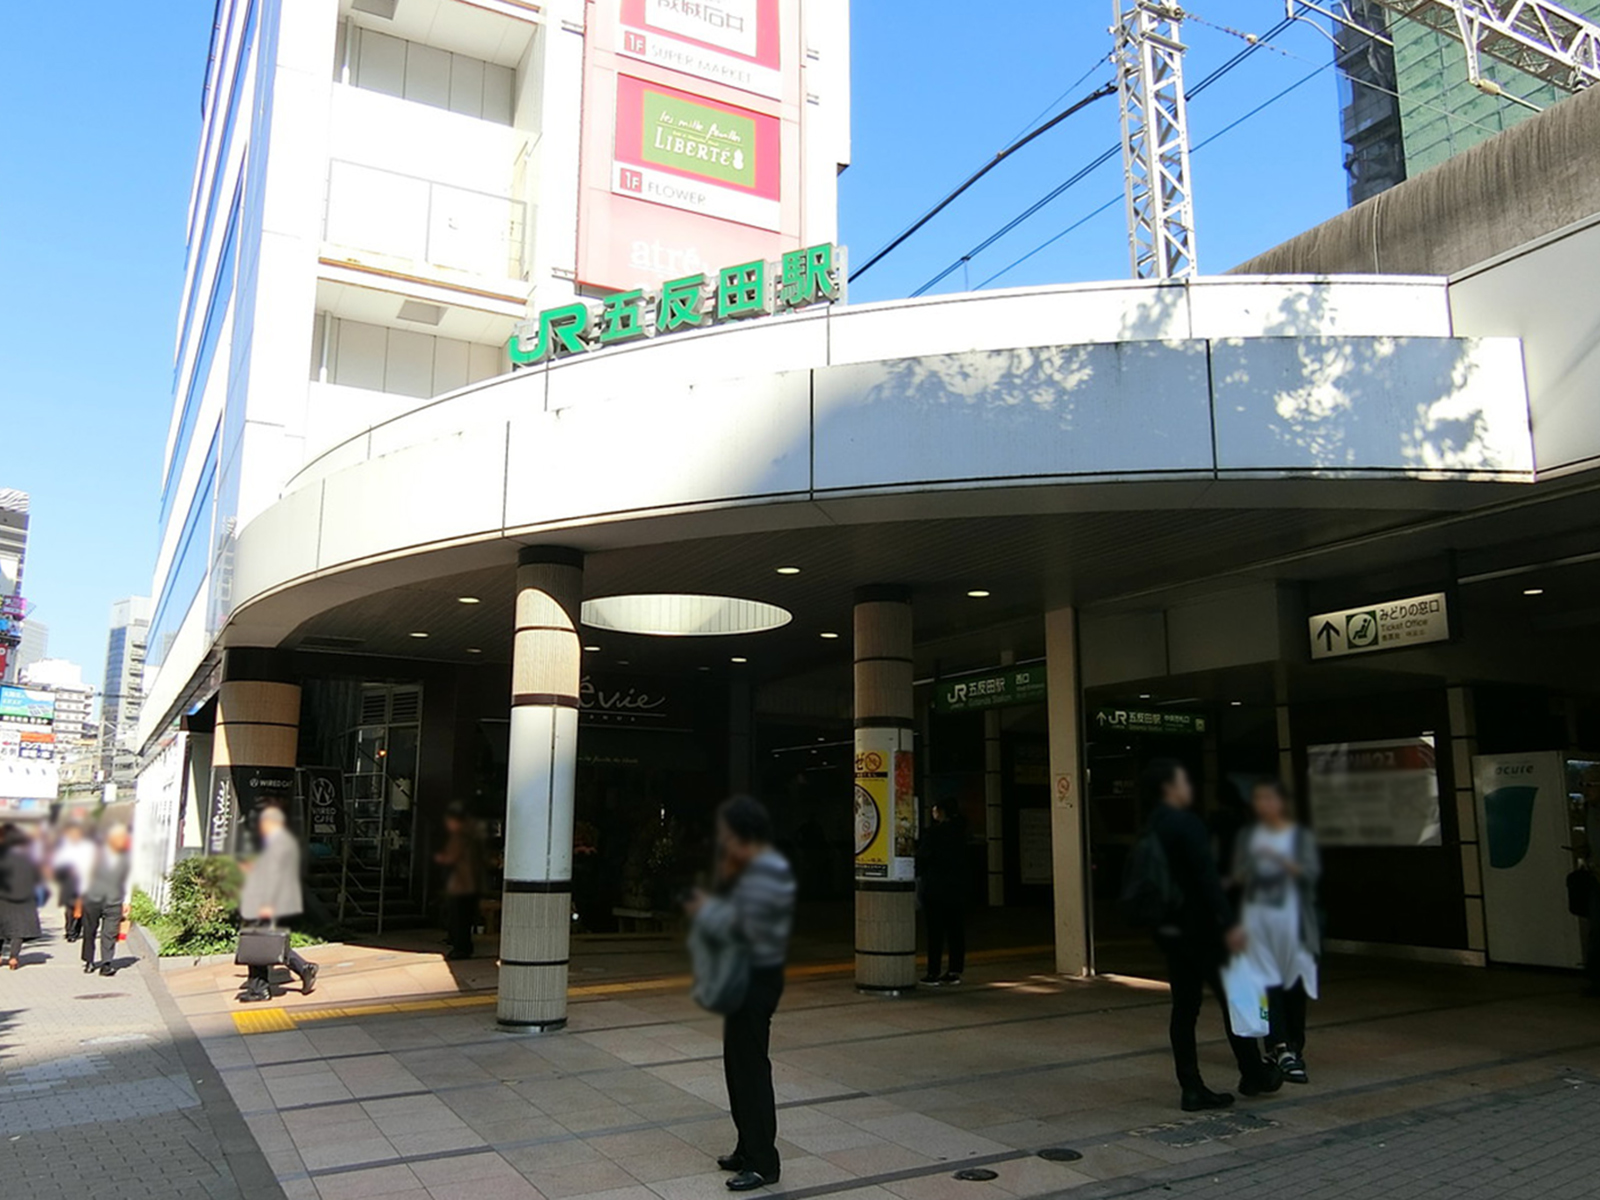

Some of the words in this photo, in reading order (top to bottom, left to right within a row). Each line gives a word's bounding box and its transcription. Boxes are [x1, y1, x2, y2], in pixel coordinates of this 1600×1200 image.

[629, 34, 645, 54] 1F
[651, 45, 694, 66] SUPER
[697, 60, 752, 84] MARKET
[655, 126, 731, 166] LIBERTÉ
[625, 171, 640, 191] 1F
[648, 181, 706, 205] FLOWER
[1379, 600, 1440, 621] みどりの窓口
[1404, 619, 1428, 630] Office
